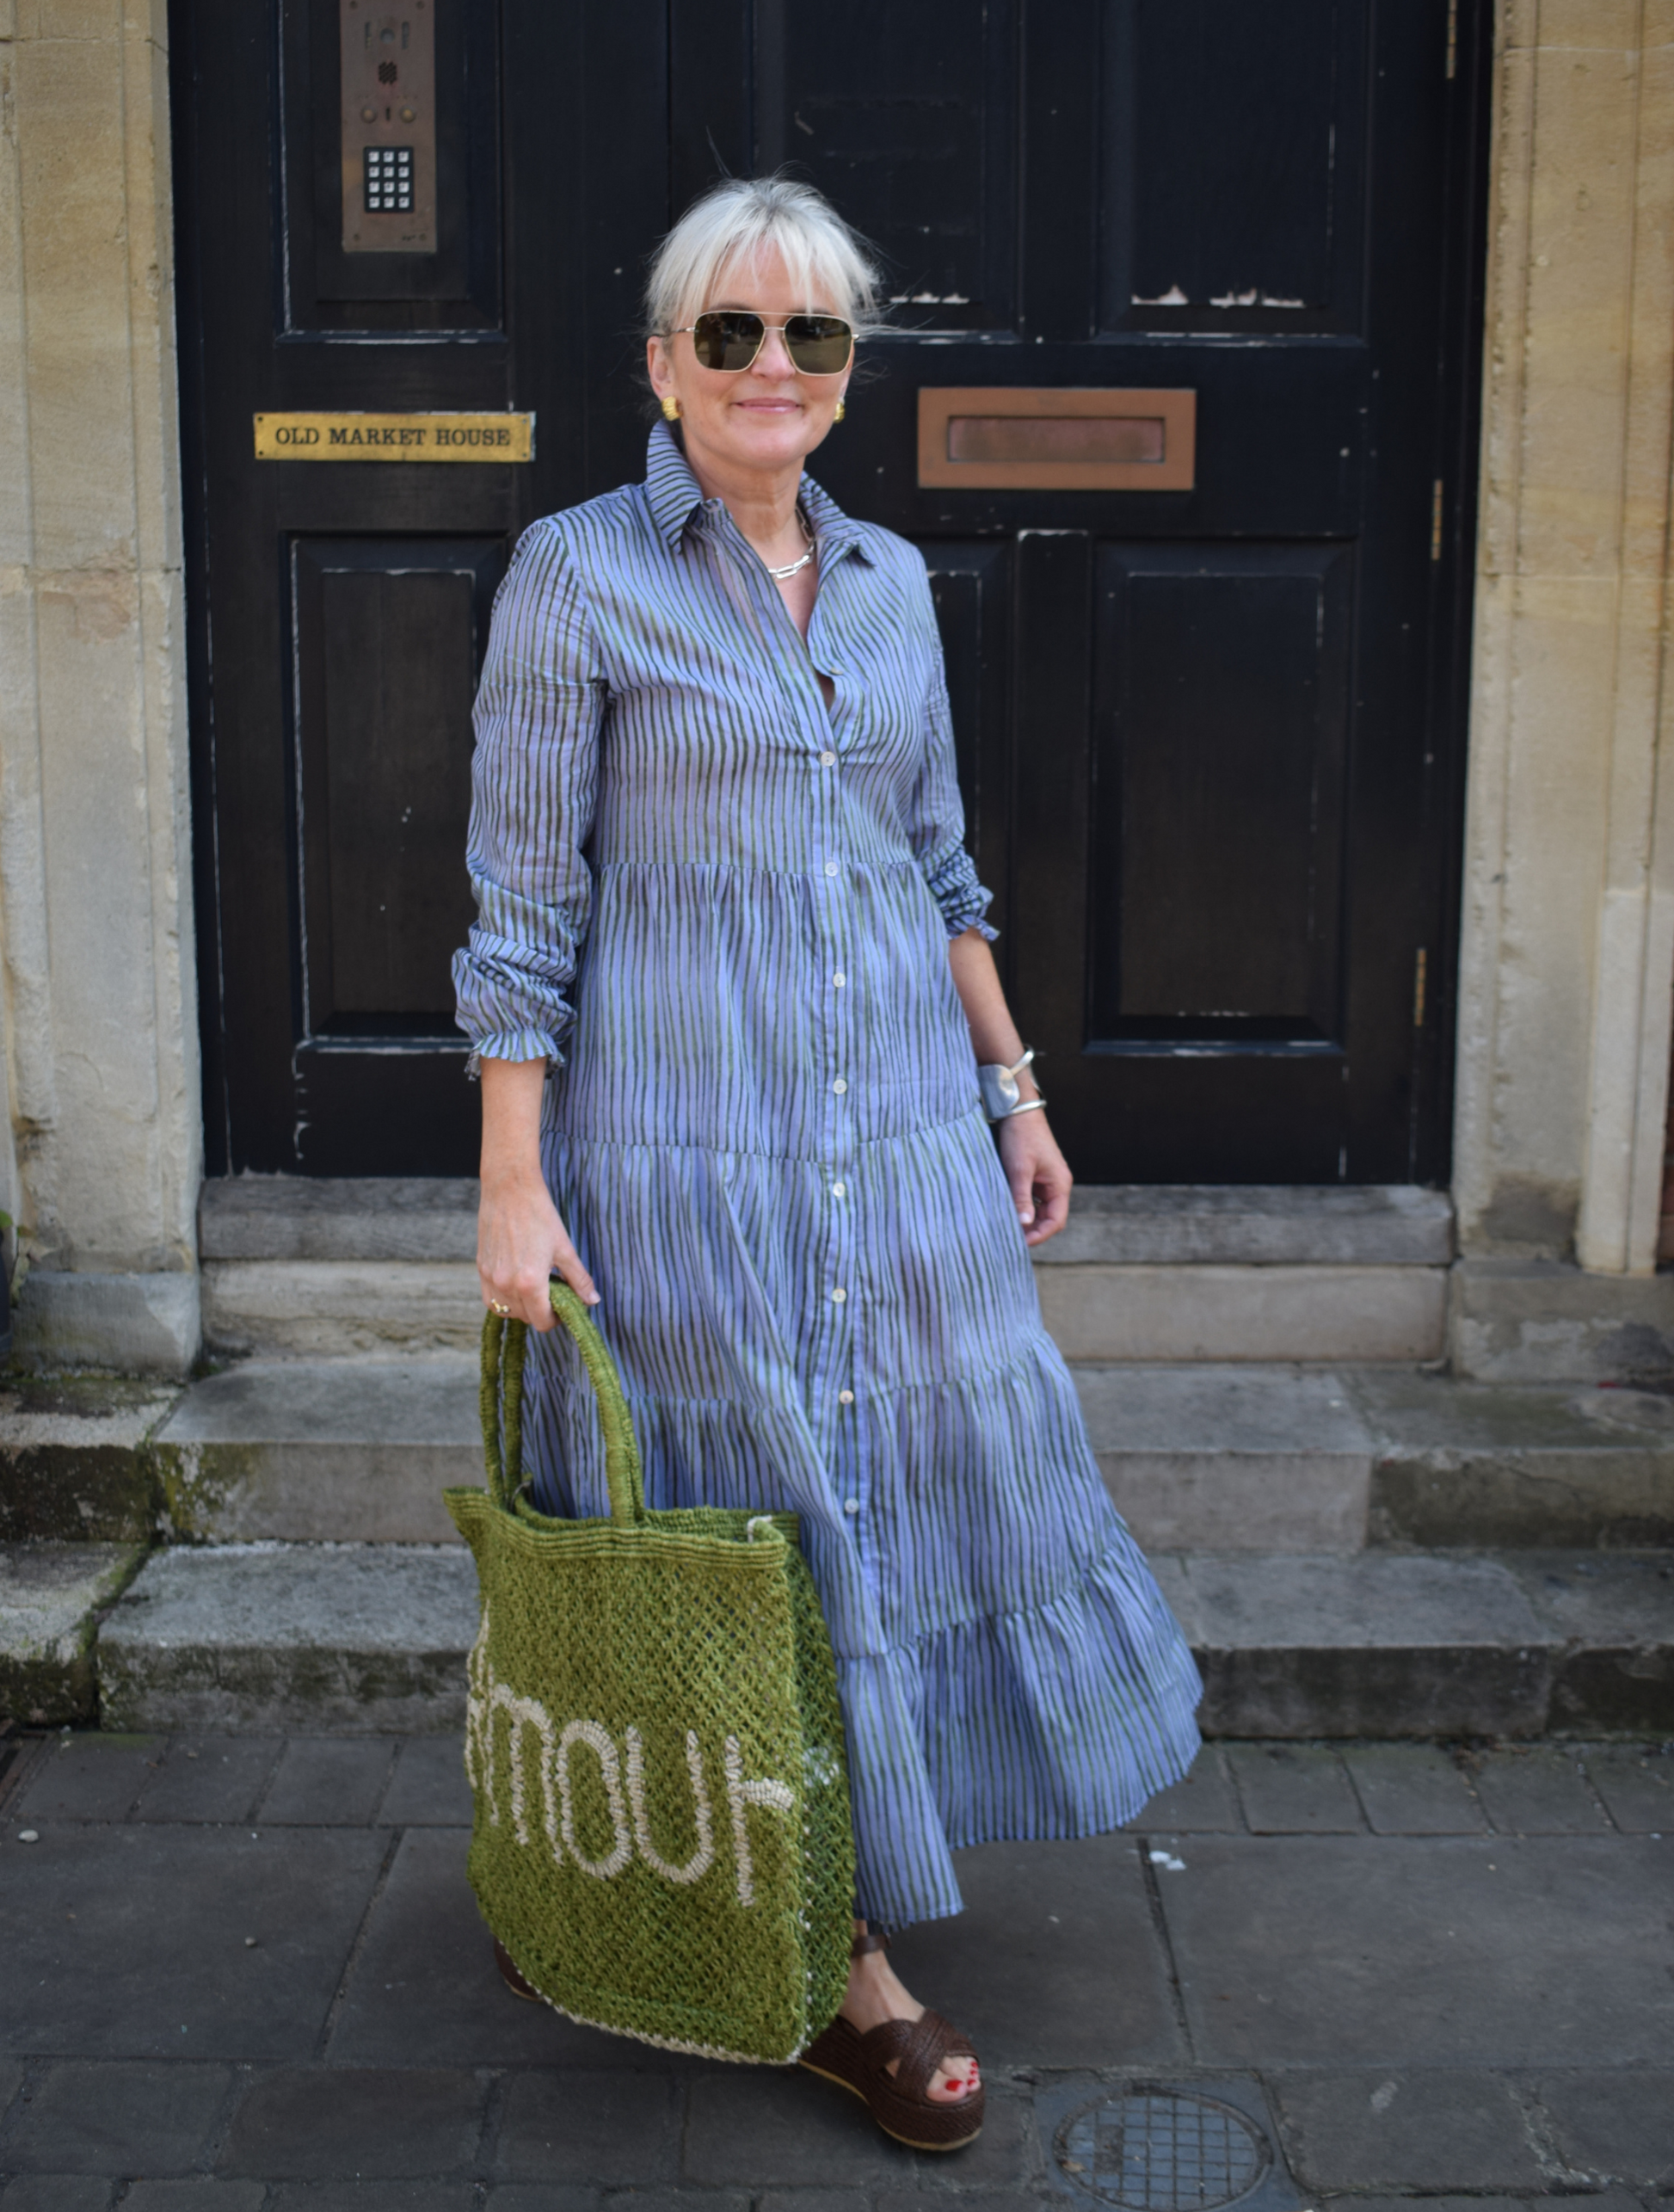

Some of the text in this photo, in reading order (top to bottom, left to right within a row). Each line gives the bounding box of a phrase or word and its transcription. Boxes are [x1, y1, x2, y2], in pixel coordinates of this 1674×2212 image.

[275, 427, 512, 447] OLD MARKET HOUSE
